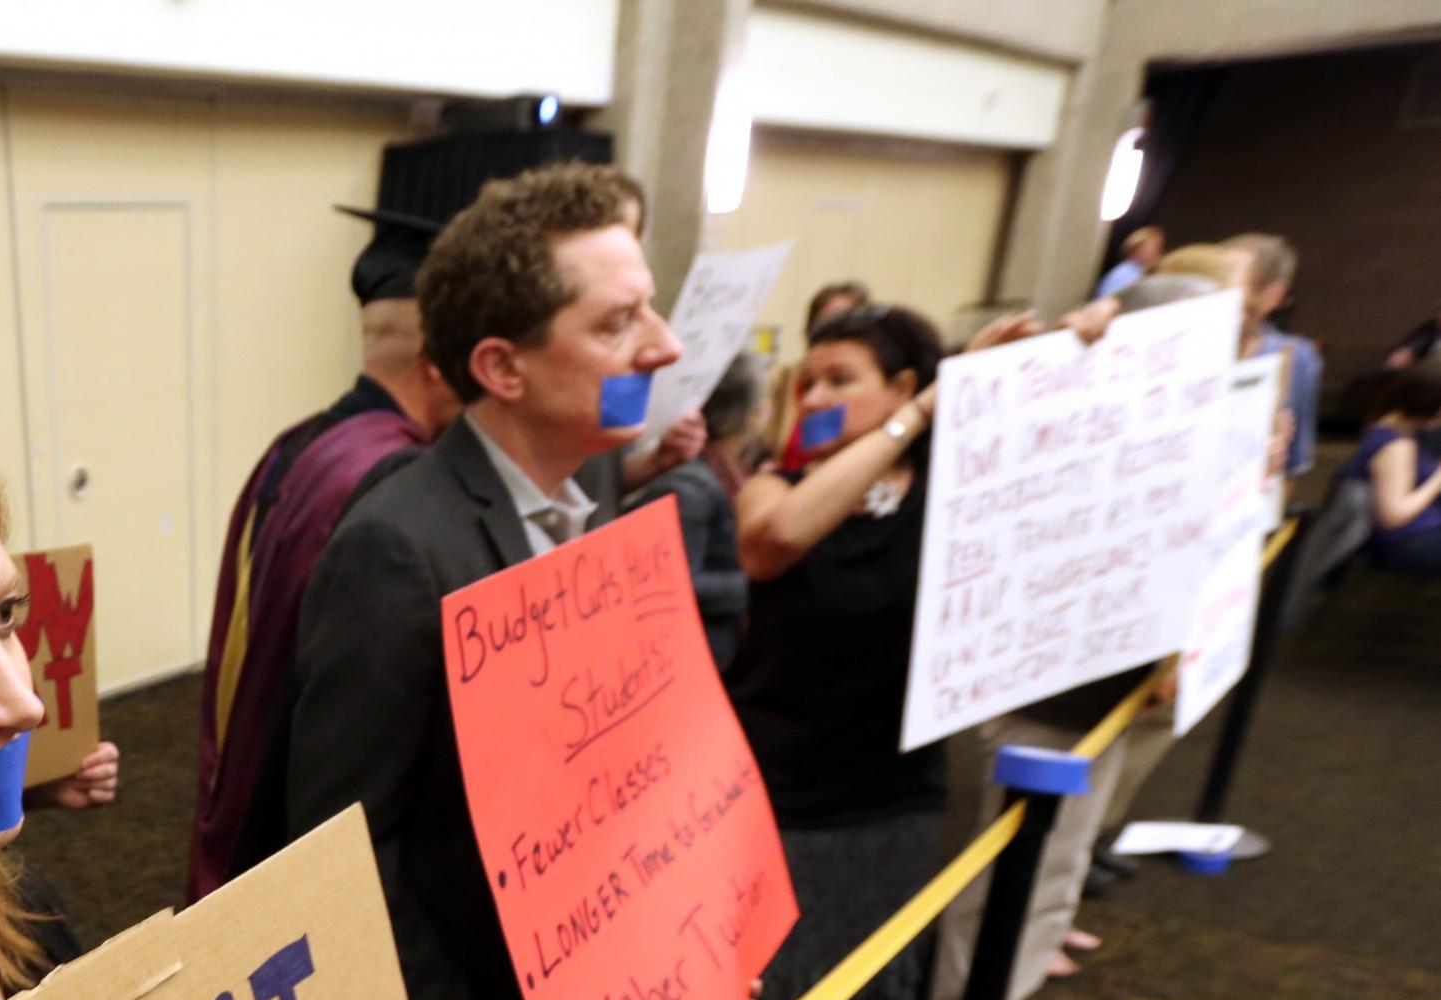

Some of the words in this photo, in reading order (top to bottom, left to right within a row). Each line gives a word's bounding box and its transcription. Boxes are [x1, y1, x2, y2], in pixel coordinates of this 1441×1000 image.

[455, 567, 568, 688] Budget
[572, 553, 624, 622] Cuts
[511, 832, 583, 892] Fewer
[588, 744, 671, 825] Classes
[534, 870, 629, 979] LONGER
